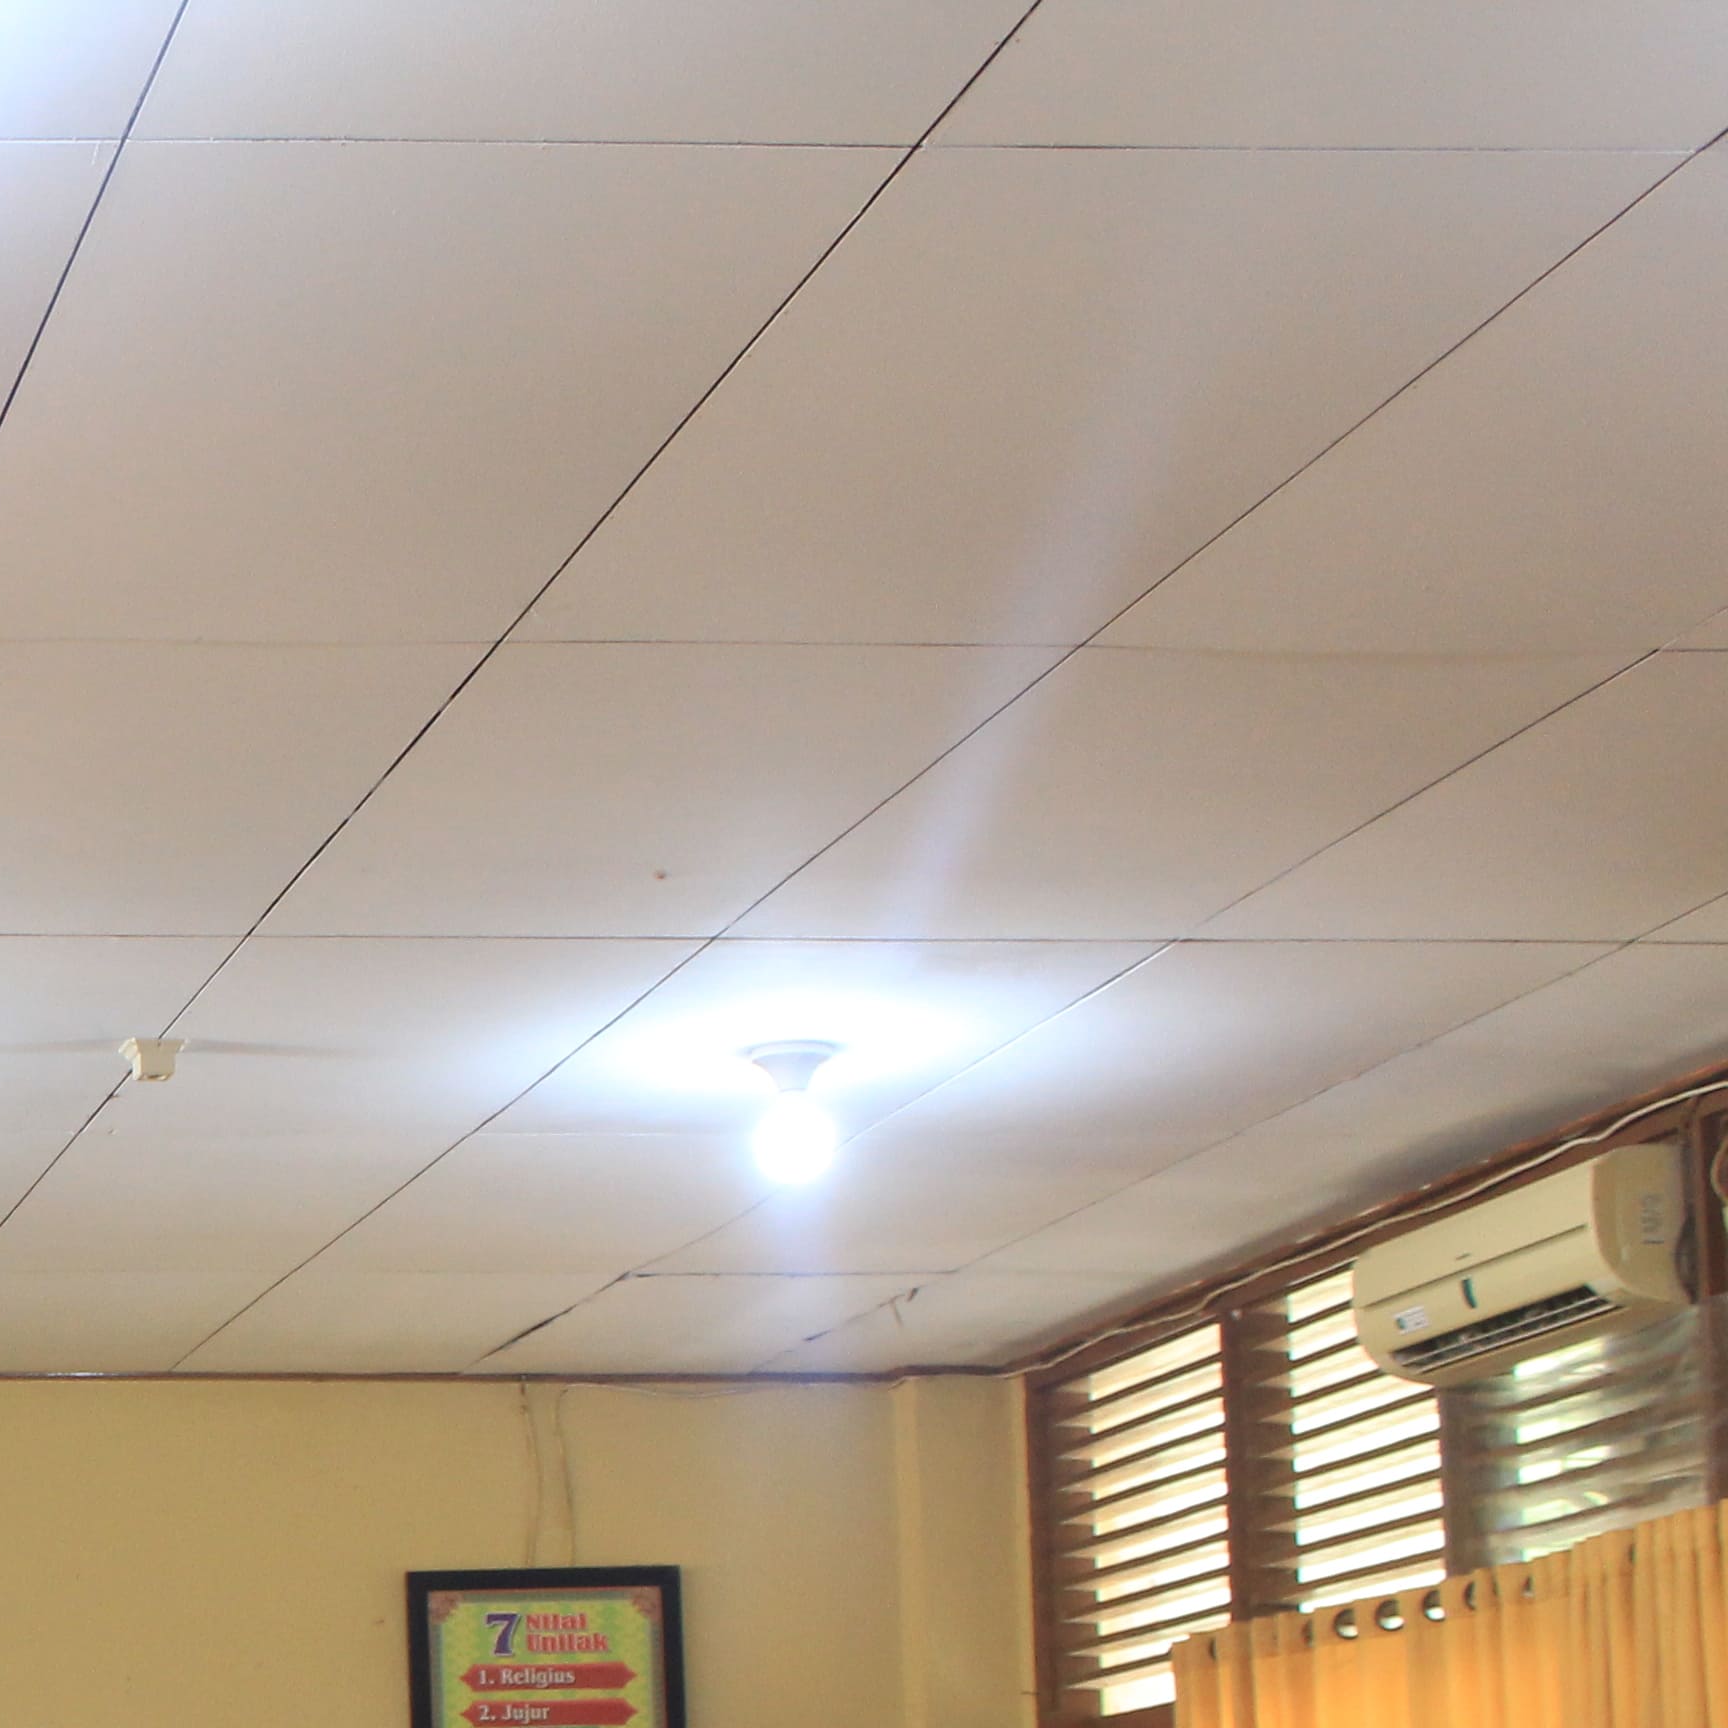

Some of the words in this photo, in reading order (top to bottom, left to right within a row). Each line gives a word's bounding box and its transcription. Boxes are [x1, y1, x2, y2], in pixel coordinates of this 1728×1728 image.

[486, 1613, 520, 1655] 7
[479, 1669, 494, 1685] 1.
[500, 1667, 575, 1687] Religius
[479, 1705, 496, 1721] 2.
[501, 1704, 550, 1723] Jujur
